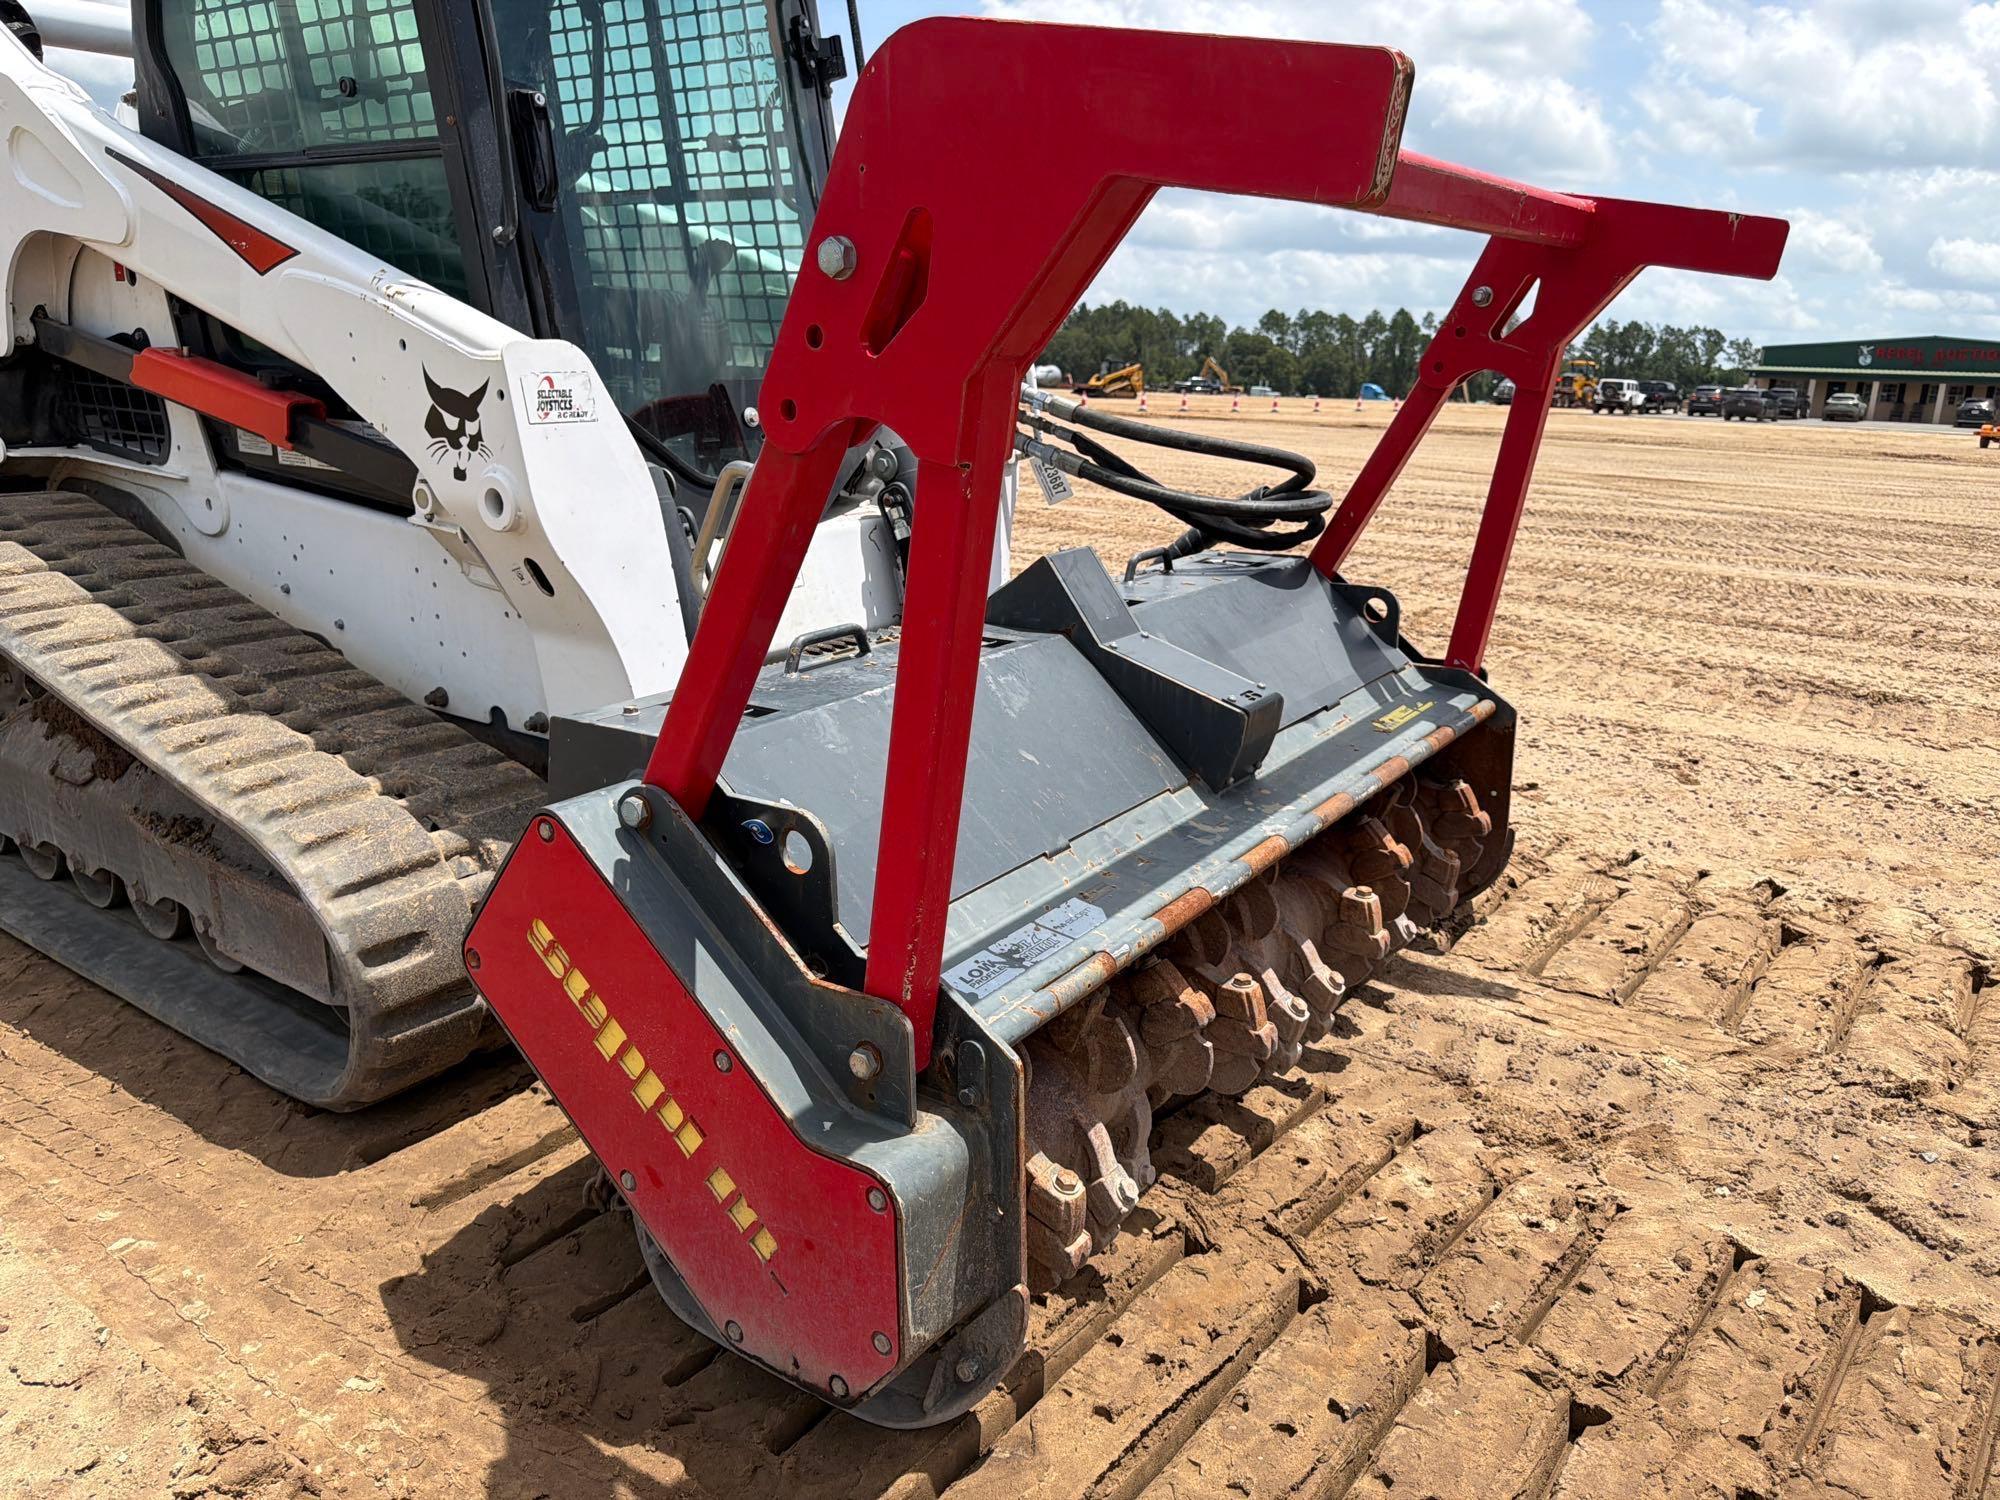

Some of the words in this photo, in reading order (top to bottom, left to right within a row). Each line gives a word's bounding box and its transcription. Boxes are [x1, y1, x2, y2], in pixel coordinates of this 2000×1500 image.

[536, 399, 573, 412] JOYSTICKS
[537, 388, 573, 399] SELECTABLE
[1042, 464, 1067, 495] 23687
[1021, 937, 1061, 961] CONTROL
[959, 957, 1001, 985] LOW
[969, 962, 1009, 989] PROFILE
